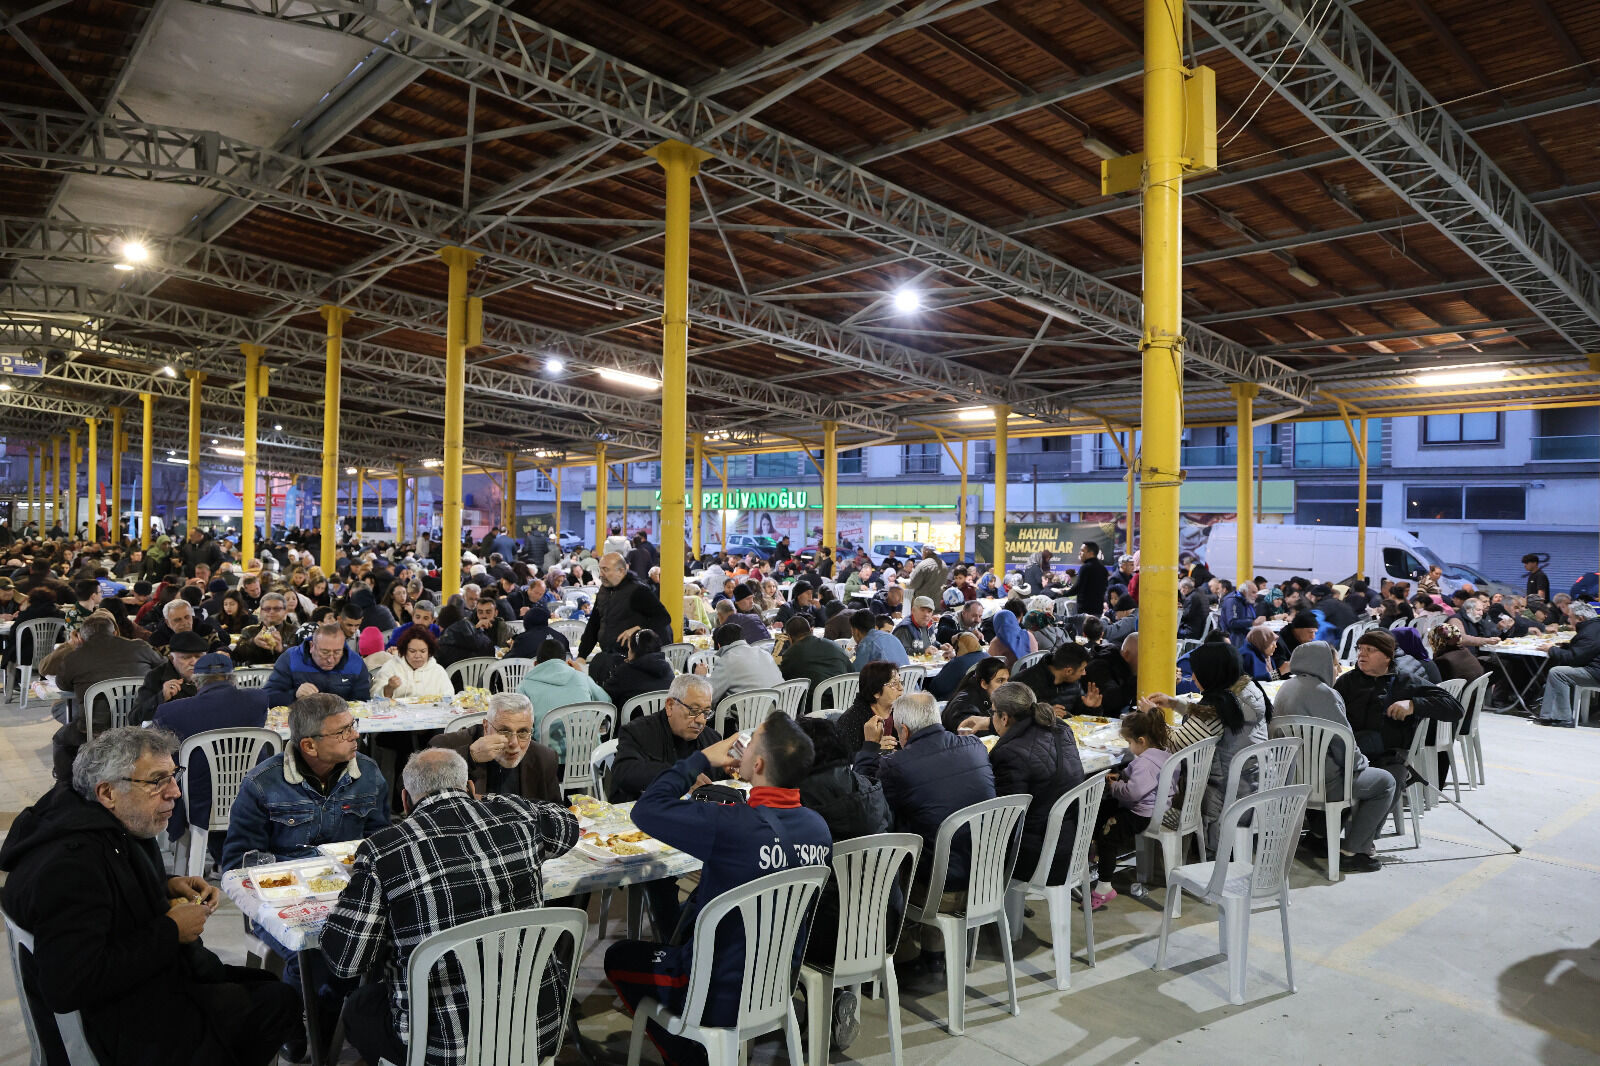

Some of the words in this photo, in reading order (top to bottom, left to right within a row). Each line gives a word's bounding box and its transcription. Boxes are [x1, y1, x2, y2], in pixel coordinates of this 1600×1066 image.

[1, 356, 12, 366] D
[1018, 527, 1059, 540] HAYIRLI
[1005, 541, 1074, 554] RAMAZANLAR
